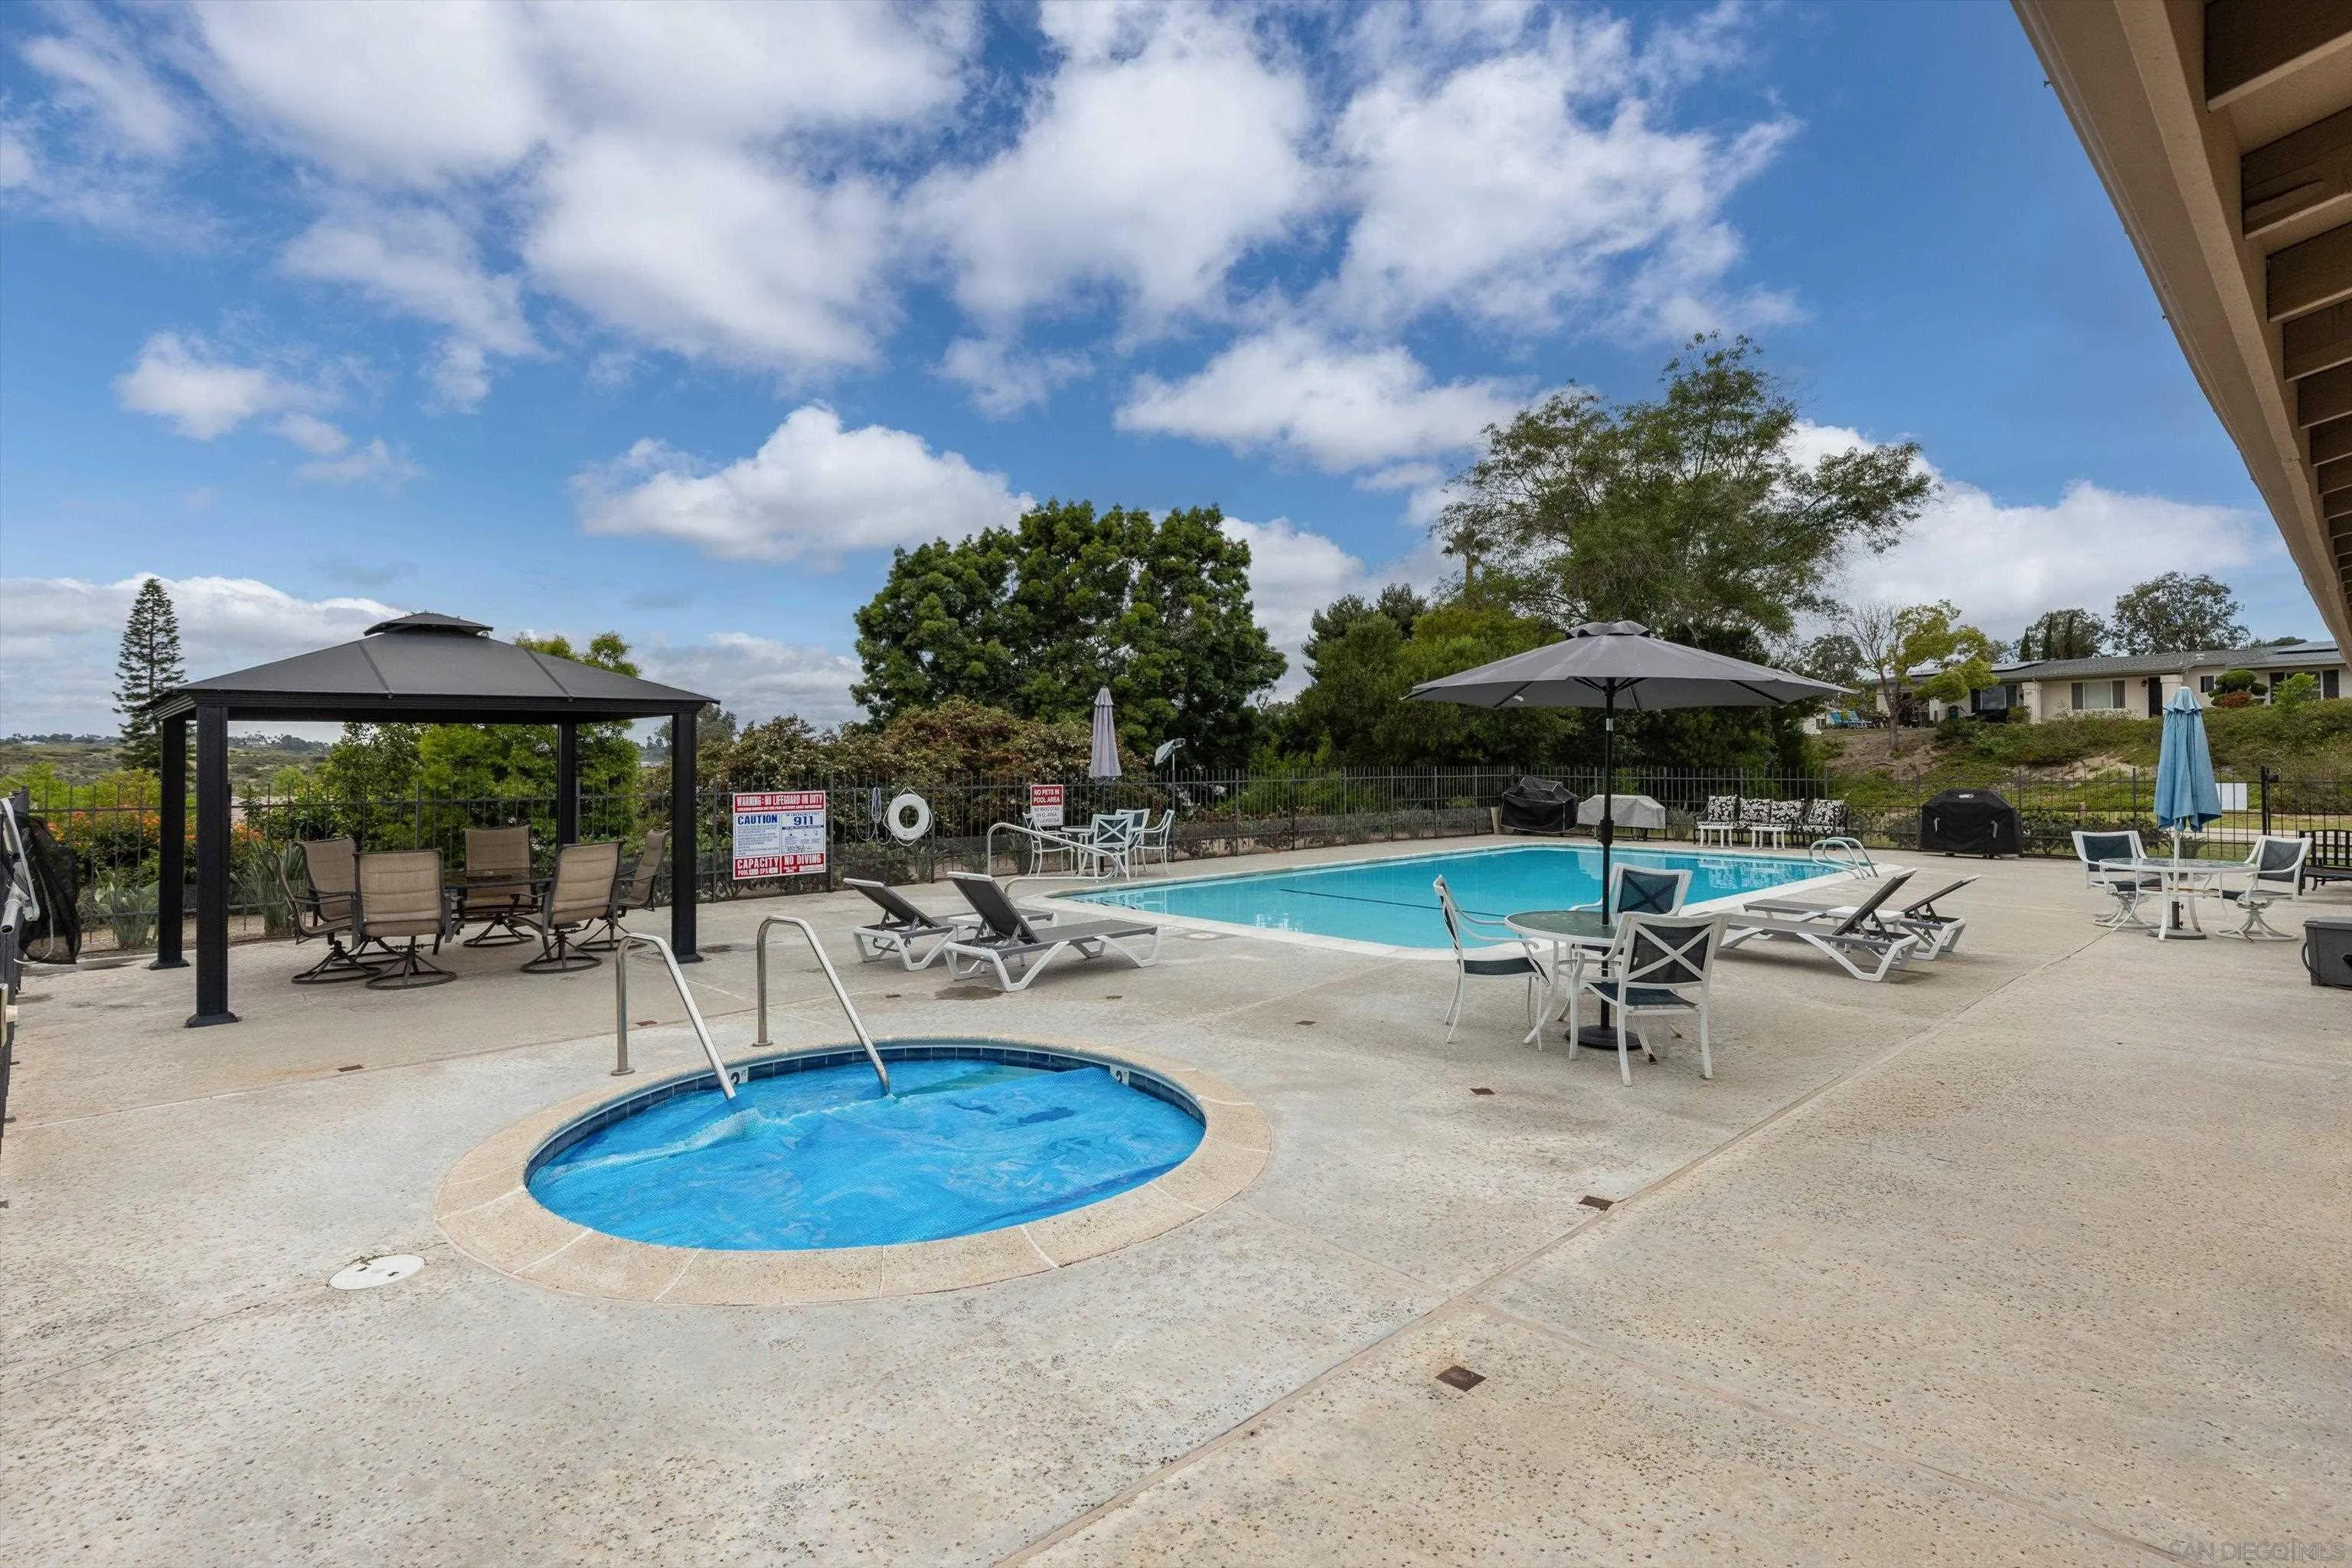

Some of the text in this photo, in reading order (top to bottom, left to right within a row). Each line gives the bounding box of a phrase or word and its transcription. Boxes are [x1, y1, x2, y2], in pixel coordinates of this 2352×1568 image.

[766, 795, 772, 805] NO
[773, 795, 800, 805] LIFEGUARD
[802, 794, 808, 804] ON
[809, 794, 822, 804] DUTY
[738, 815, 778, 825] CAUTION
[794, 816, 813, 825] 911
[737, 857, 779, 869] CAPACITY
[784, 854, 822, 865] NO DIVING
